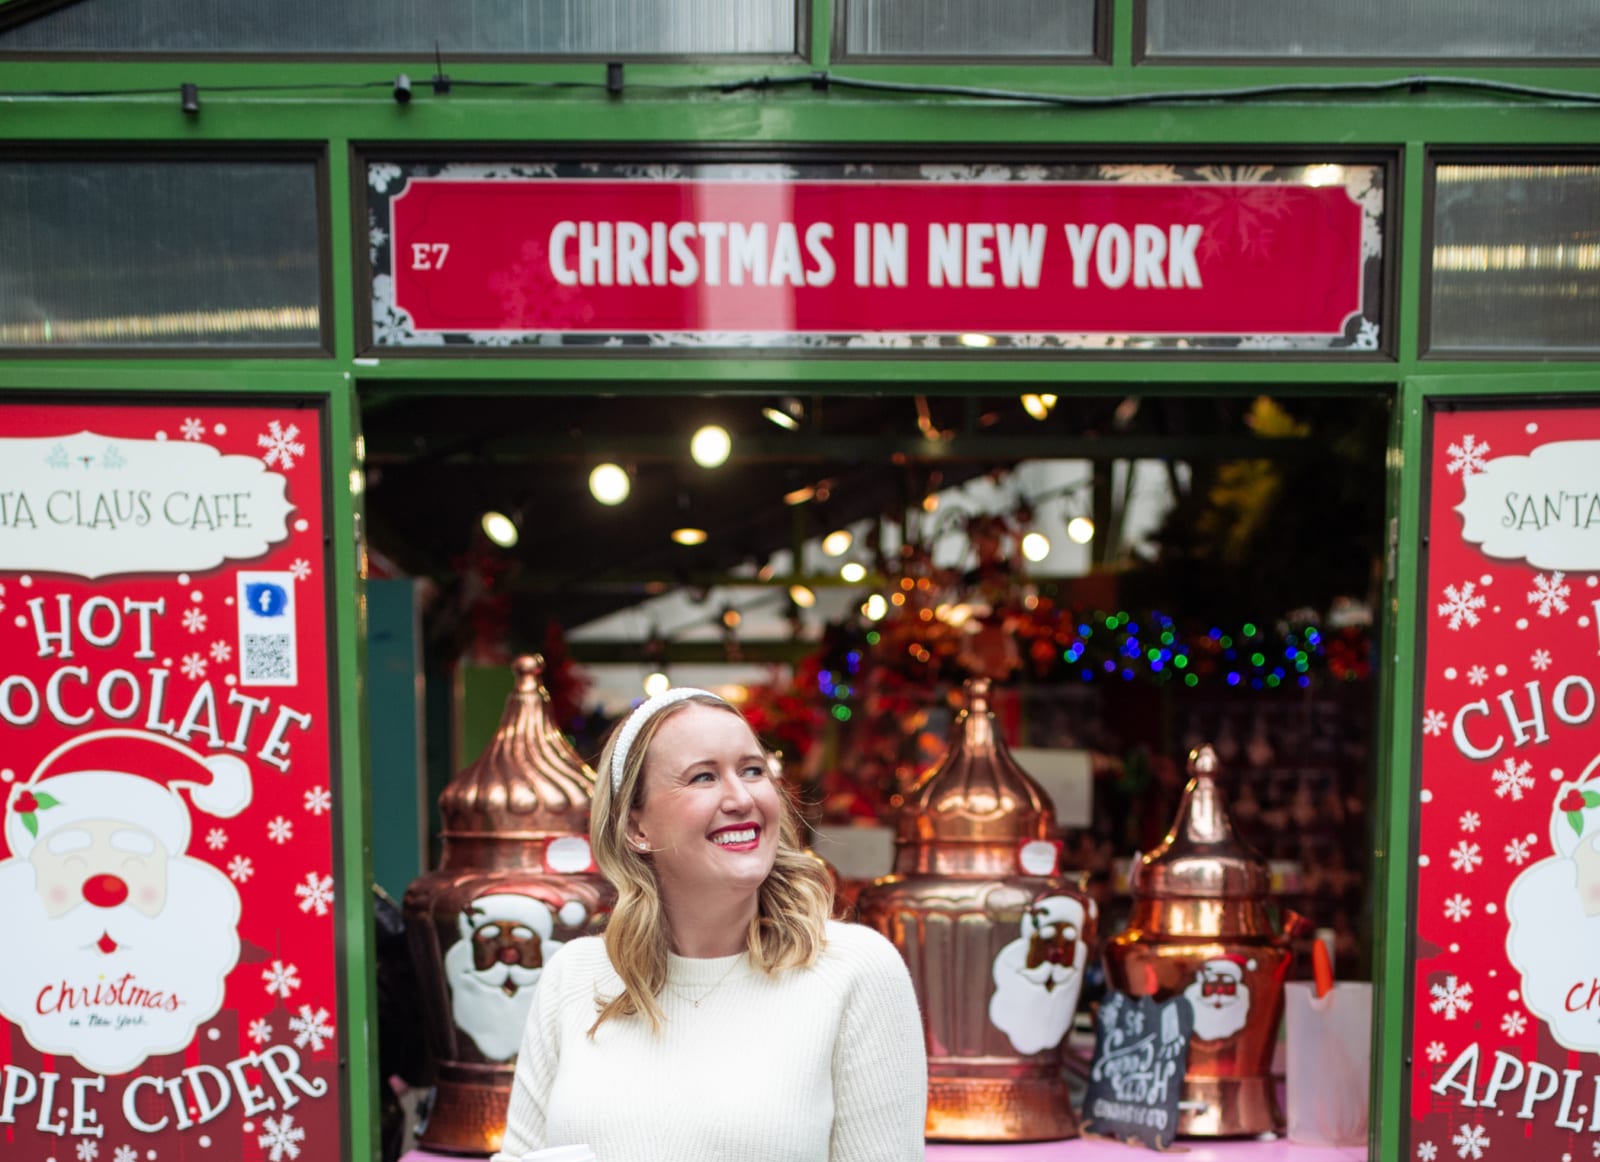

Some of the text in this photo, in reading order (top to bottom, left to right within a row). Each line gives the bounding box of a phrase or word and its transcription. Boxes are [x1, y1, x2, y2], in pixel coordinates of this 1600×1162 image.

[411, 243, 450, 270] E7
[548, 221, 1203, 289] CHRISTMAS IN NEW YORK
[46, 490, 152, 531] CLAUS
[163, 491, 253, 531] CAFE
[27, 594, 165, 660] HOT
[0, 665, 313, 774] OCOLATE
[1452, 675, 1596, 761] CHO
[35, 972, 186, 1016] Christmas
[122, 1044, 329, 1133] CIDER
